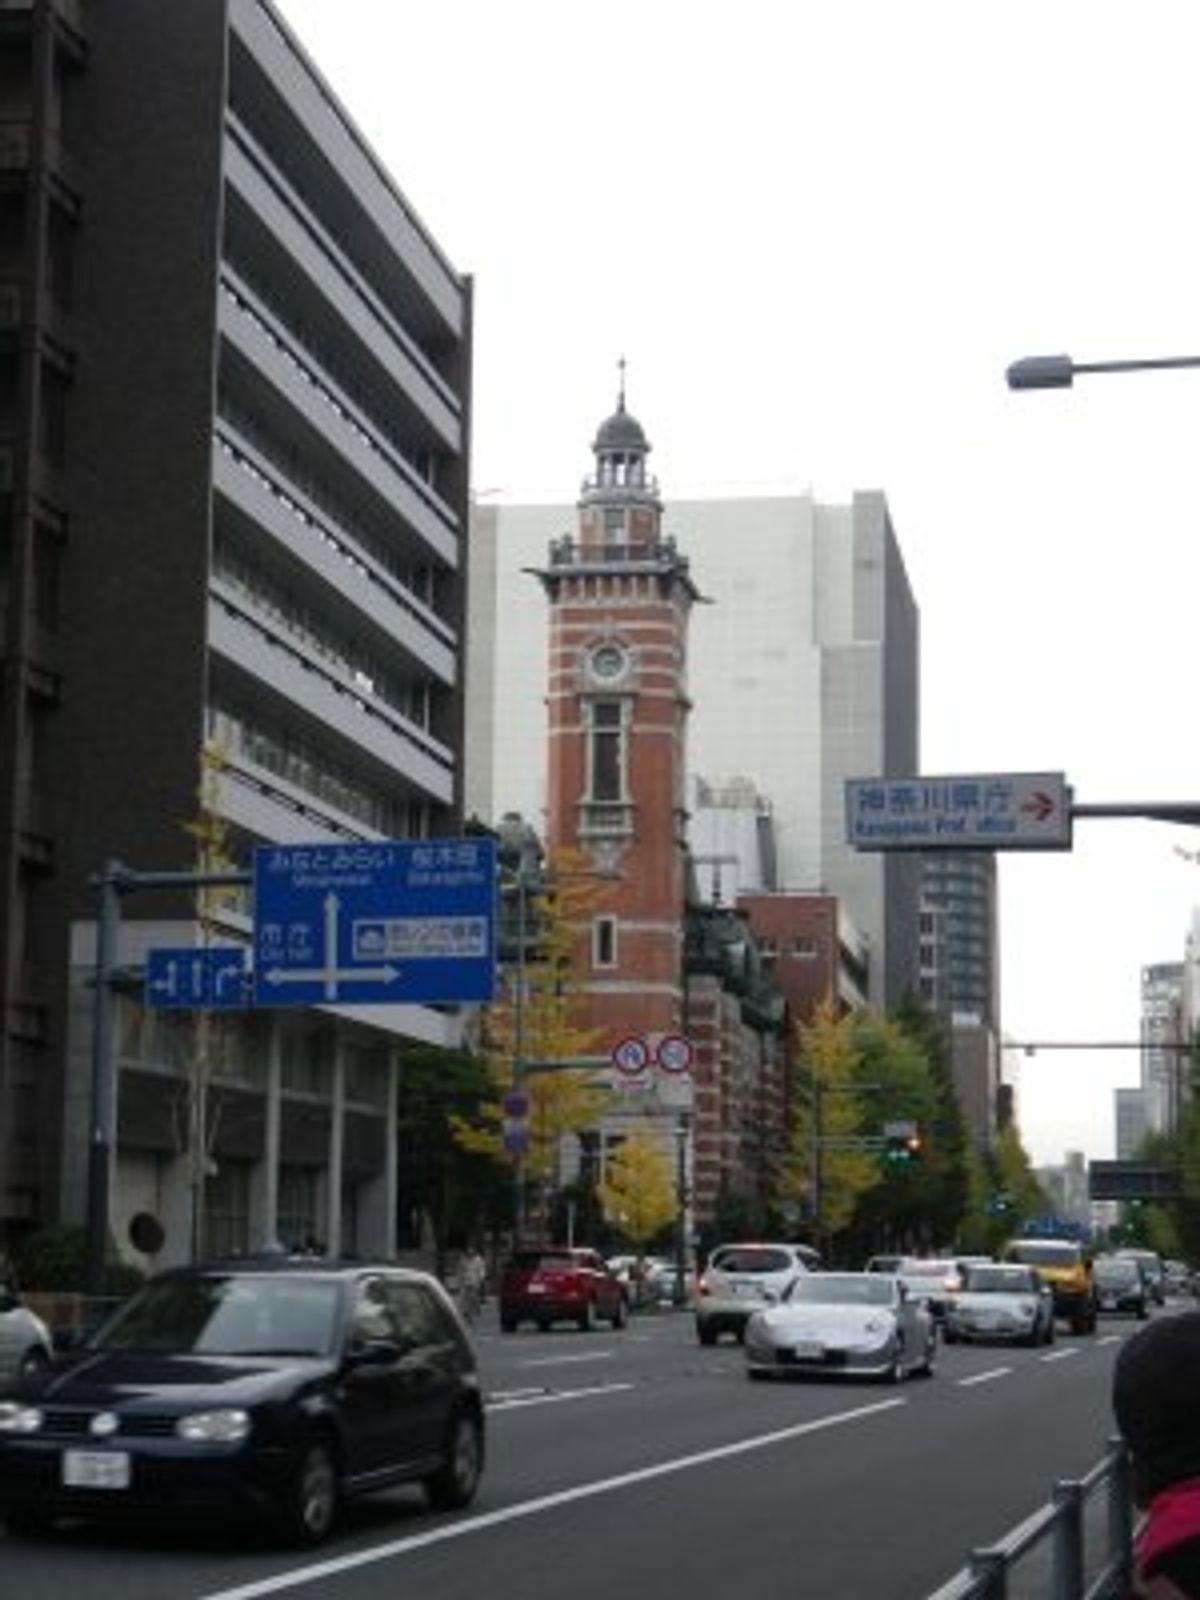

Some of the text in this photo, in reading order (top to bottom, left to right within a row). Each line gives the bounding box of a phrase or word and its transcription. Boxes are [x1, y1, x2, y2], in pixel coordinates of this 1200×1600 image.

[858, 783, 1014, 815] 神奈川県庁
[267, 848, 395, 871] みなとみらい
